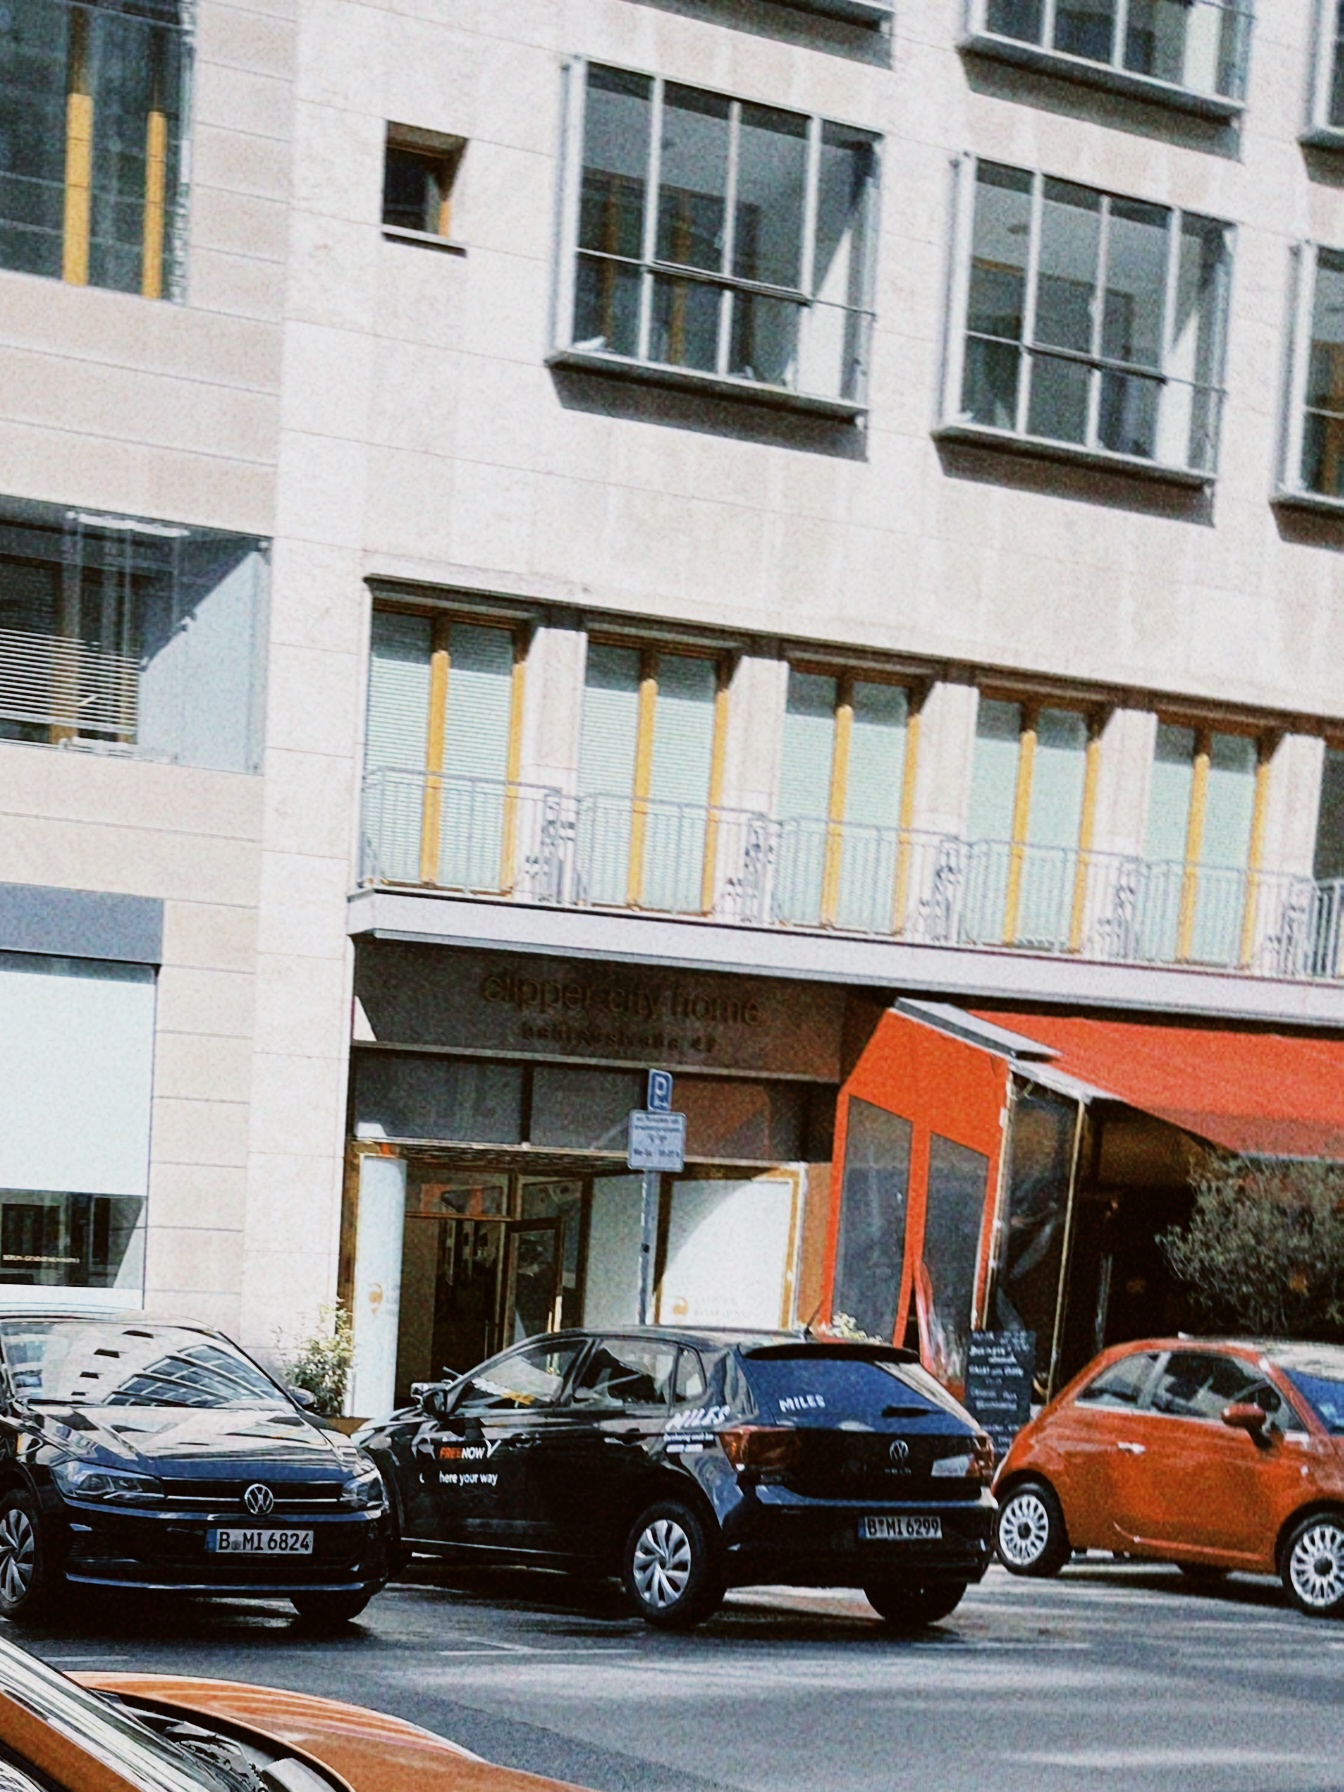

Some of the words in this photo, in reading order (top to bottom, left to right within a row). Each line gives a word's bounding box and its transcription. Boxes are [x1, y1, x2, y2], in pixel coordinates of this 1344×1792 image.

[779, 1394, 826, 1413] MILES
[459, 1473, 479, 1487] your
[480, 1473, 498, 1487] way
